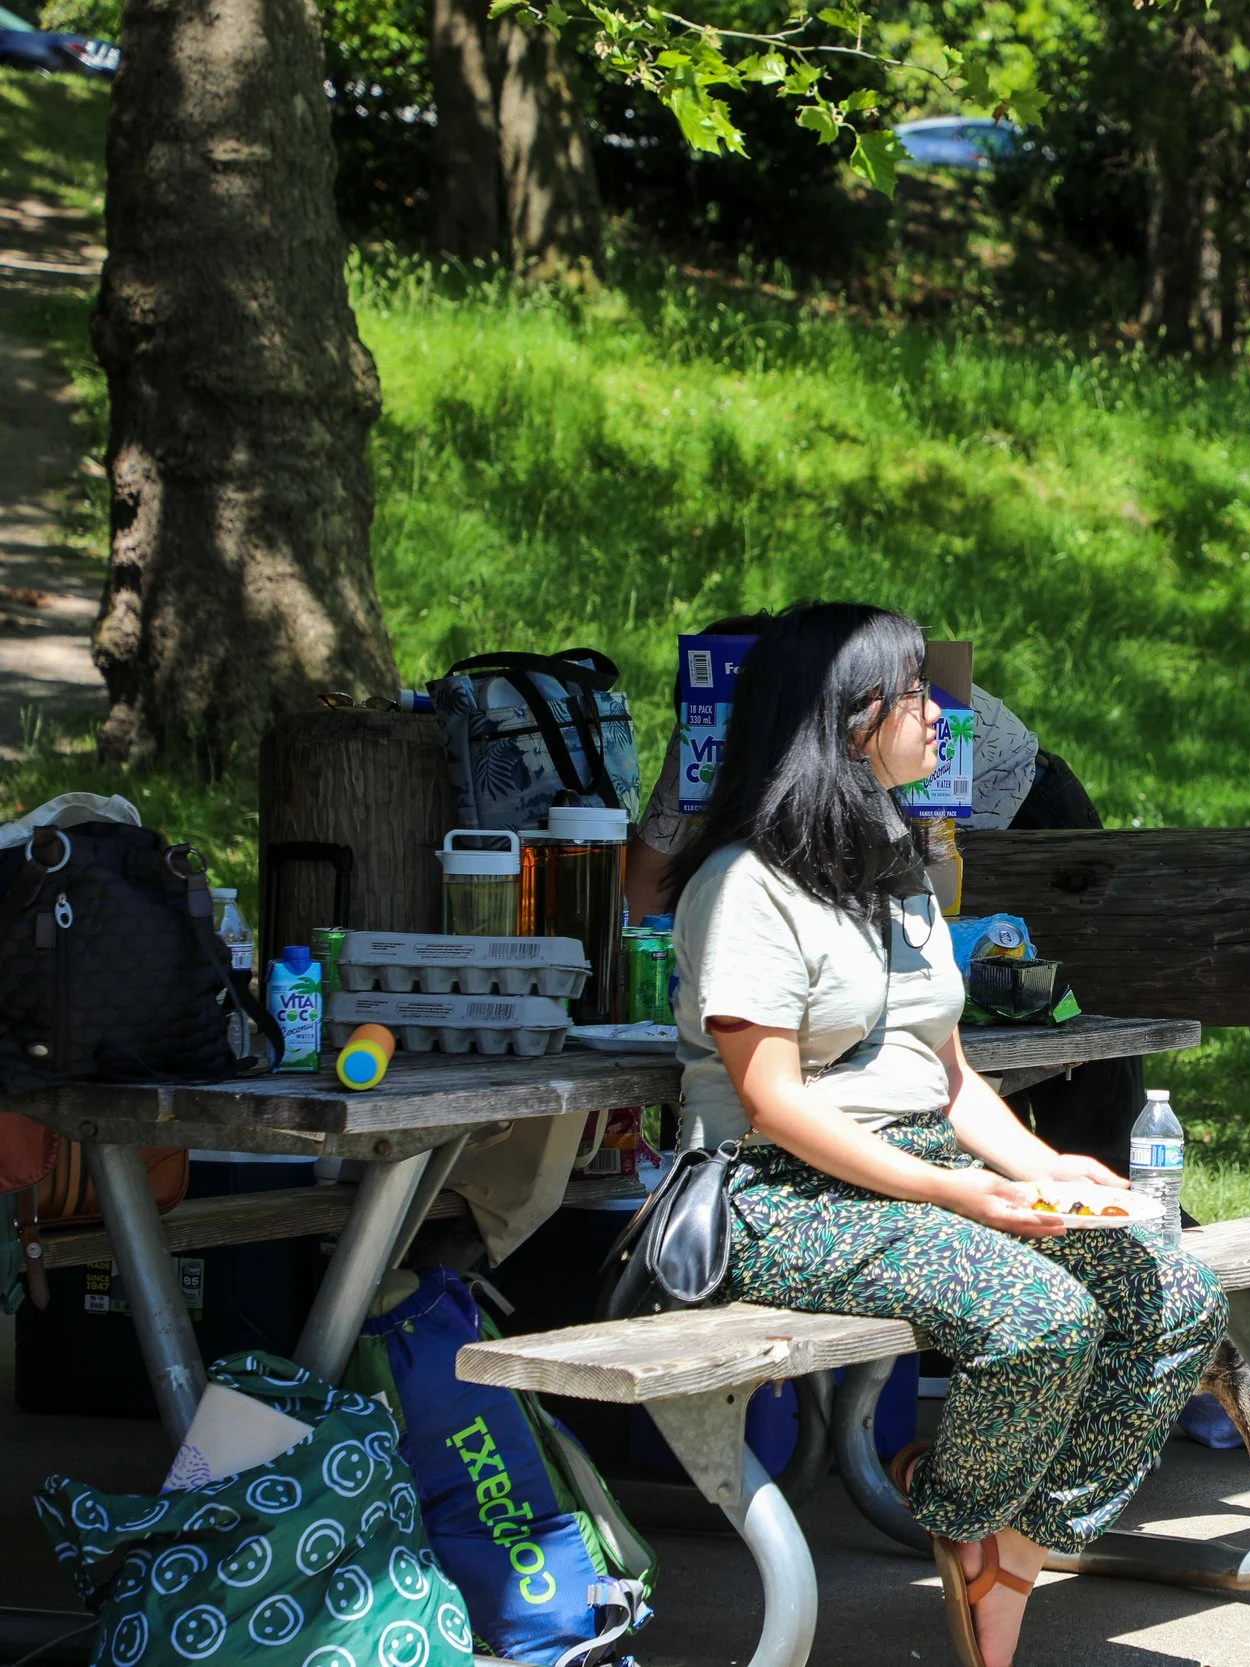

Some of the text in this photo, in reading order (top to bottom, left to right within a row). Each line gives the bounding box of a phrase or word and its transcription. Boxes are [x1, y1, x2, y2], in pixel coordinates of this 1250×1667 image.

[689, 705, 713, 714] 18 PACK
[689, 715, 712, 725] 330 mL
[689, 735, 727, 763] VIT
[280, 992, 314, 1009] VITA
[277, 1009, 318, 1023] COCO
[183, 1276, 200, 1285] 85
